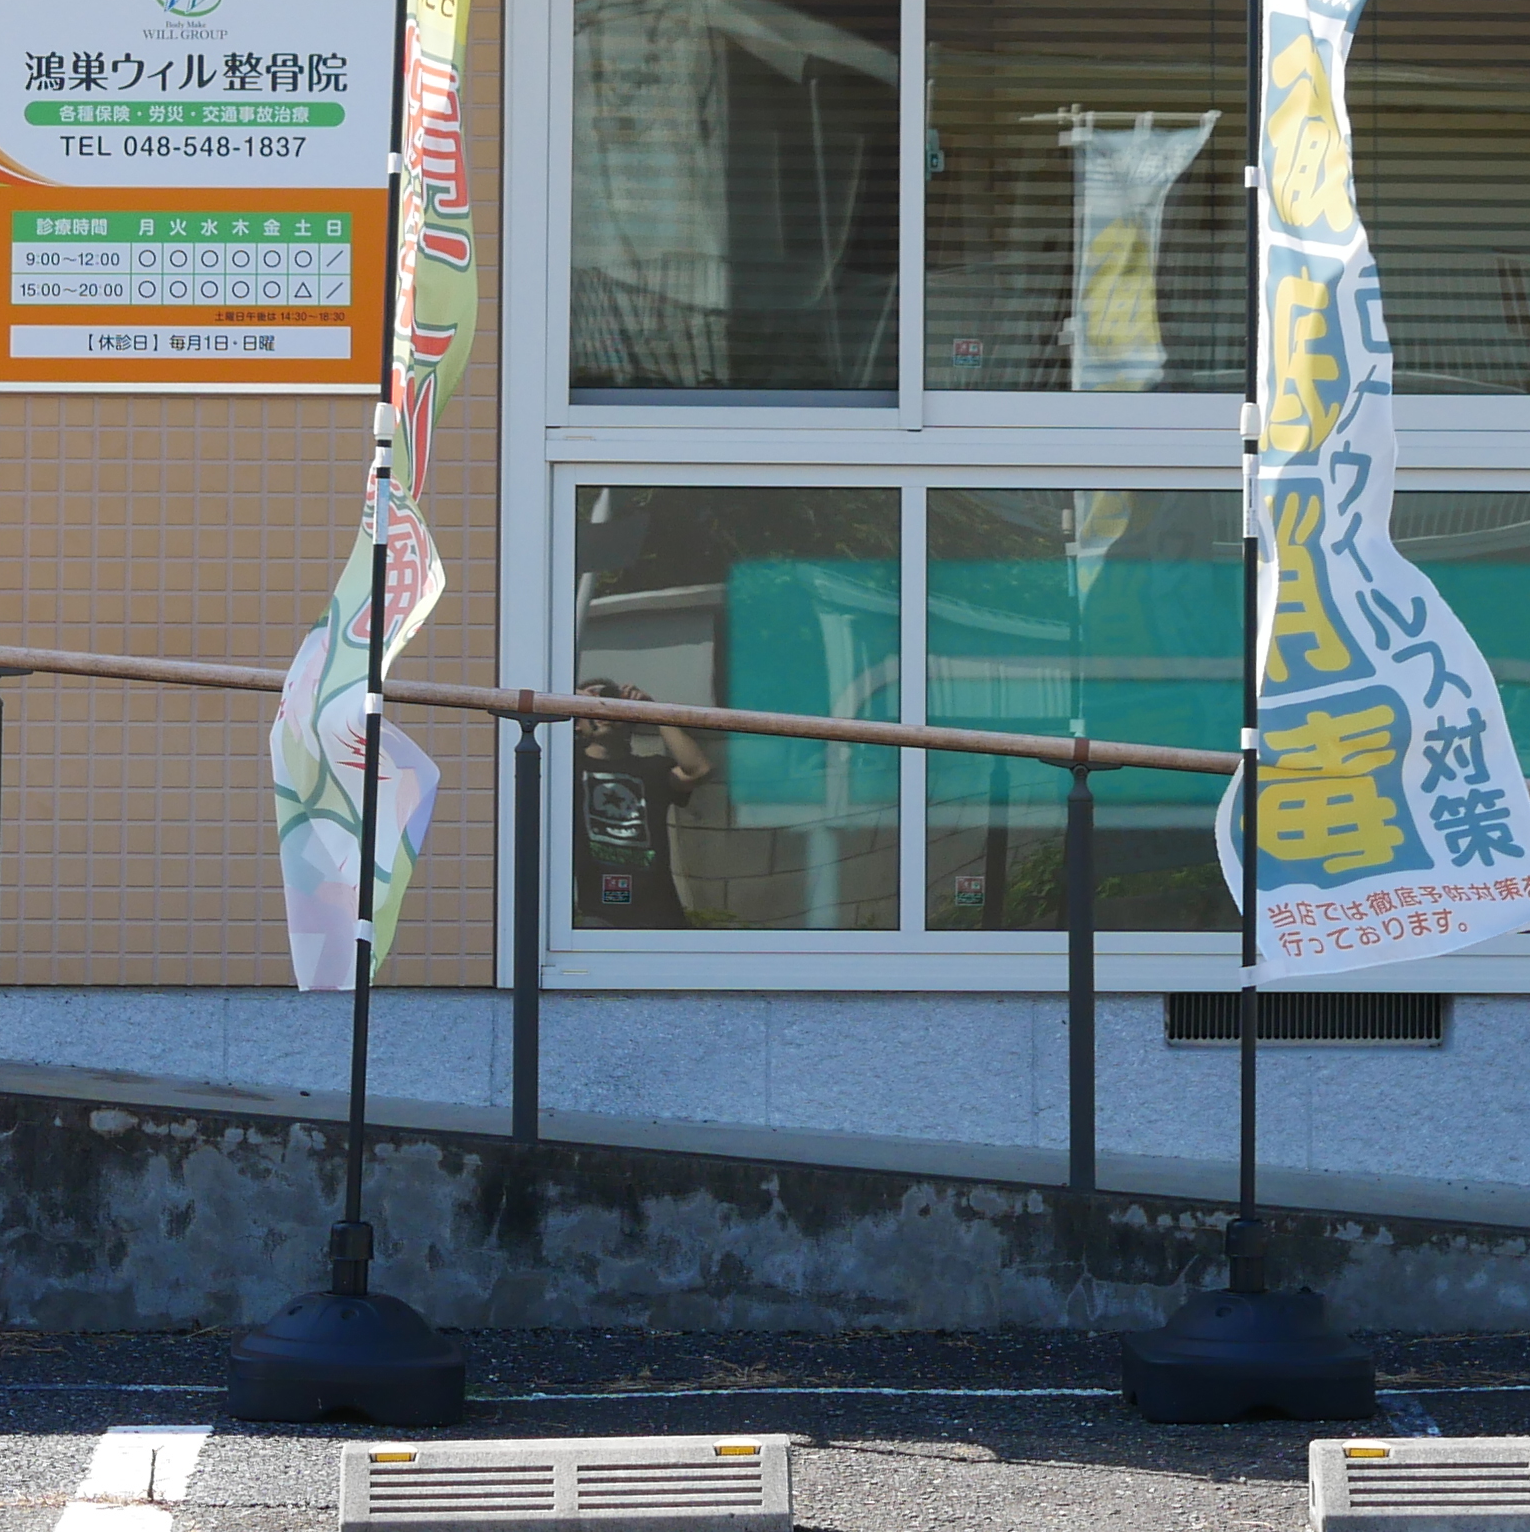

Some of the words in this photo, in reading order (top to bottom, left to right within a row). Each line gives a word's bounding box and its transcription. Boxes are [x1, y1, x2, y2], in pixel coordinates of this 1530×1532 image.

[142, 29, 179, 40] WILL
[180, 29, 229, 41] GROUP
[165, 20, 185, 30] Body
[187, 20, 207, 29] Make
[25, 51, 349, 93] 鴻巣ウィル整骨院
[58, 104, 310, 124] 各種保険・労災・交通事故治療
[60, 135, 112, 157] TEL
[123, 135, 307, 158] 048-548-1837
[36, 218, 108, 237] 診療時間
[138, 218, 155, 237] 月
[169, 219, 187, 237] 火
[200, 219, 219, 237] 水
[232, 219, 250, 237] 木
[263, 219, 281, 237] 金
[294, 220, 312, 237] 土
[326, 220, 342, 237] 日
[1277, 908, 1469, 958] 行っております。
